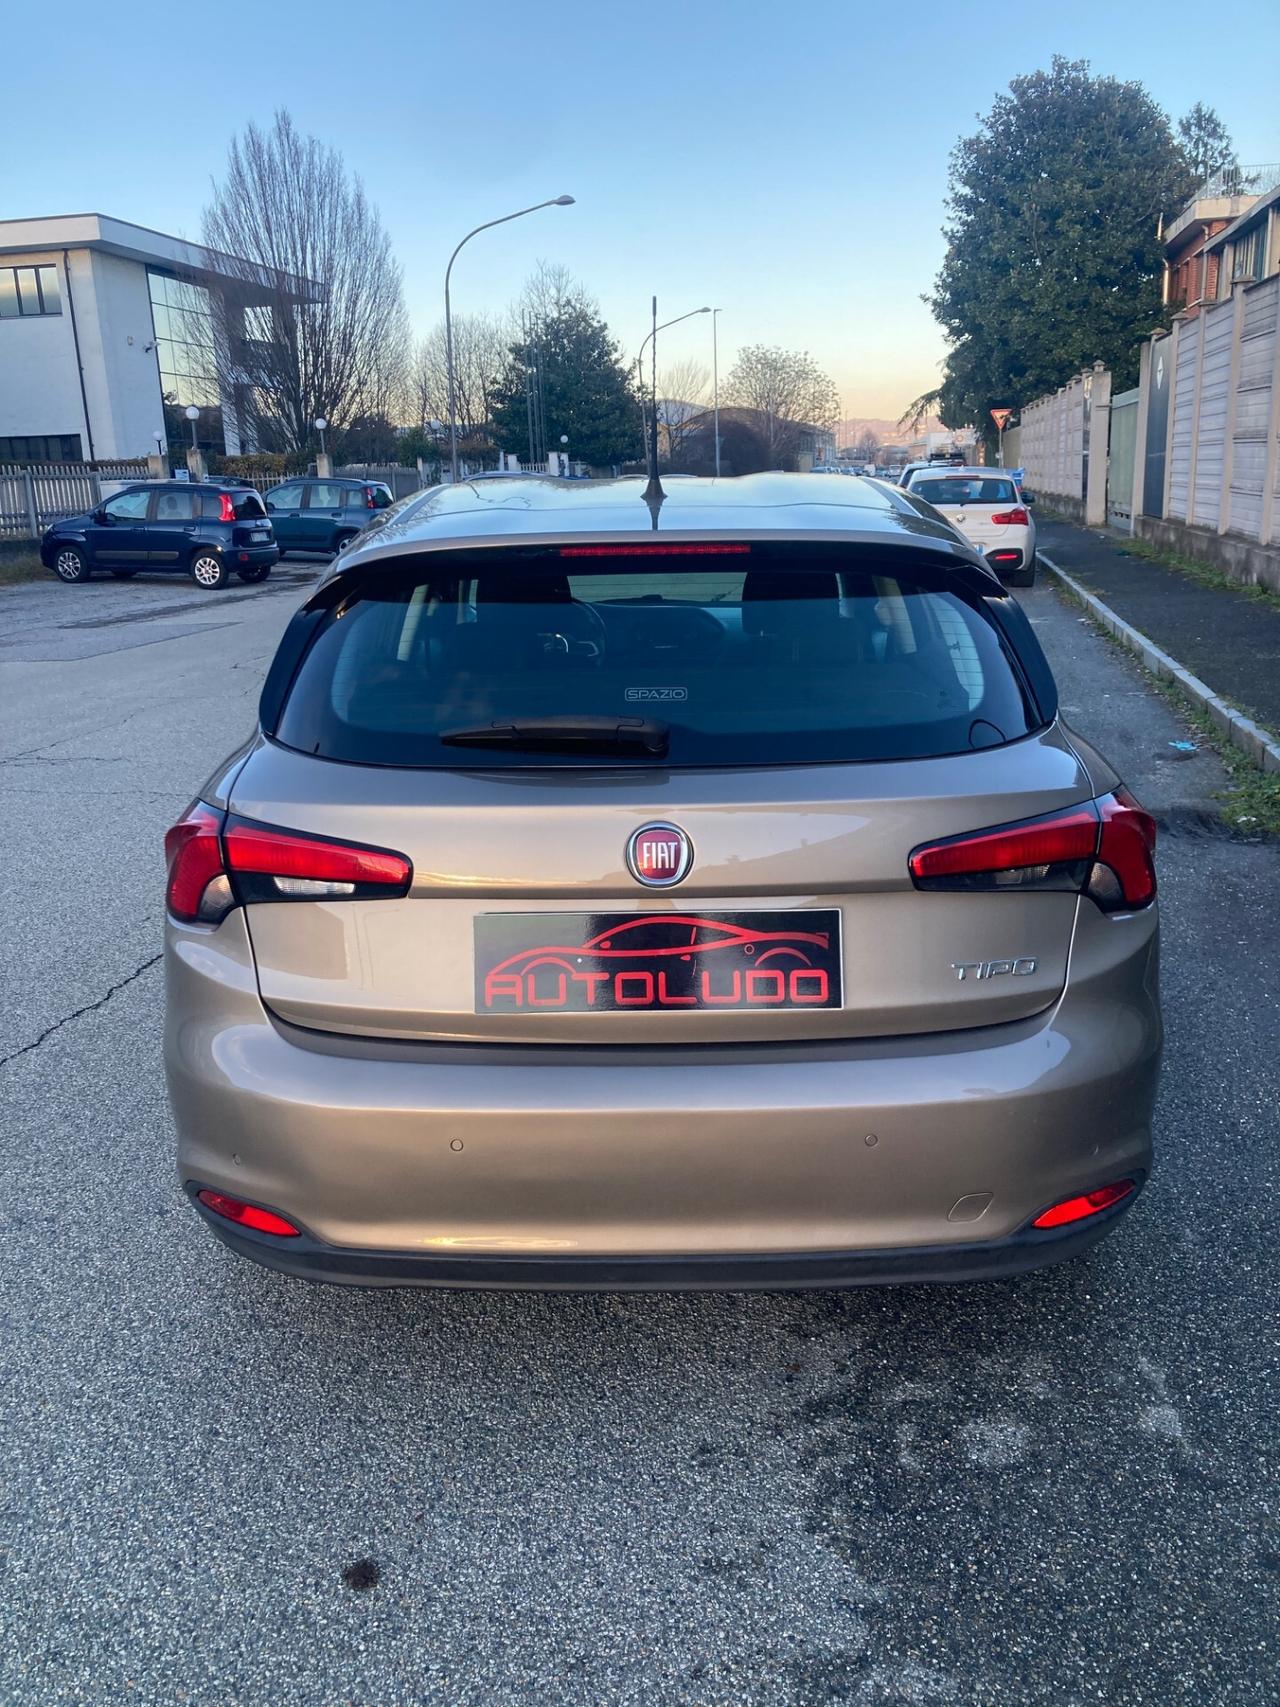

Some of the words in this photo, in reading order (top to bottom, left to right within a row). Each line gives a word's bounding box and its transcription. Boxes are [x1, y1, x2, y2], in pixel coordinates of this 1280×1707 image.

[627, 689, 685, 699] SPAZIO
[642, 842, 678, 869] FIAT
[951, 956, 1037, 981] TIPO
[485, 968, 829, 1007] AUTOLUDO
